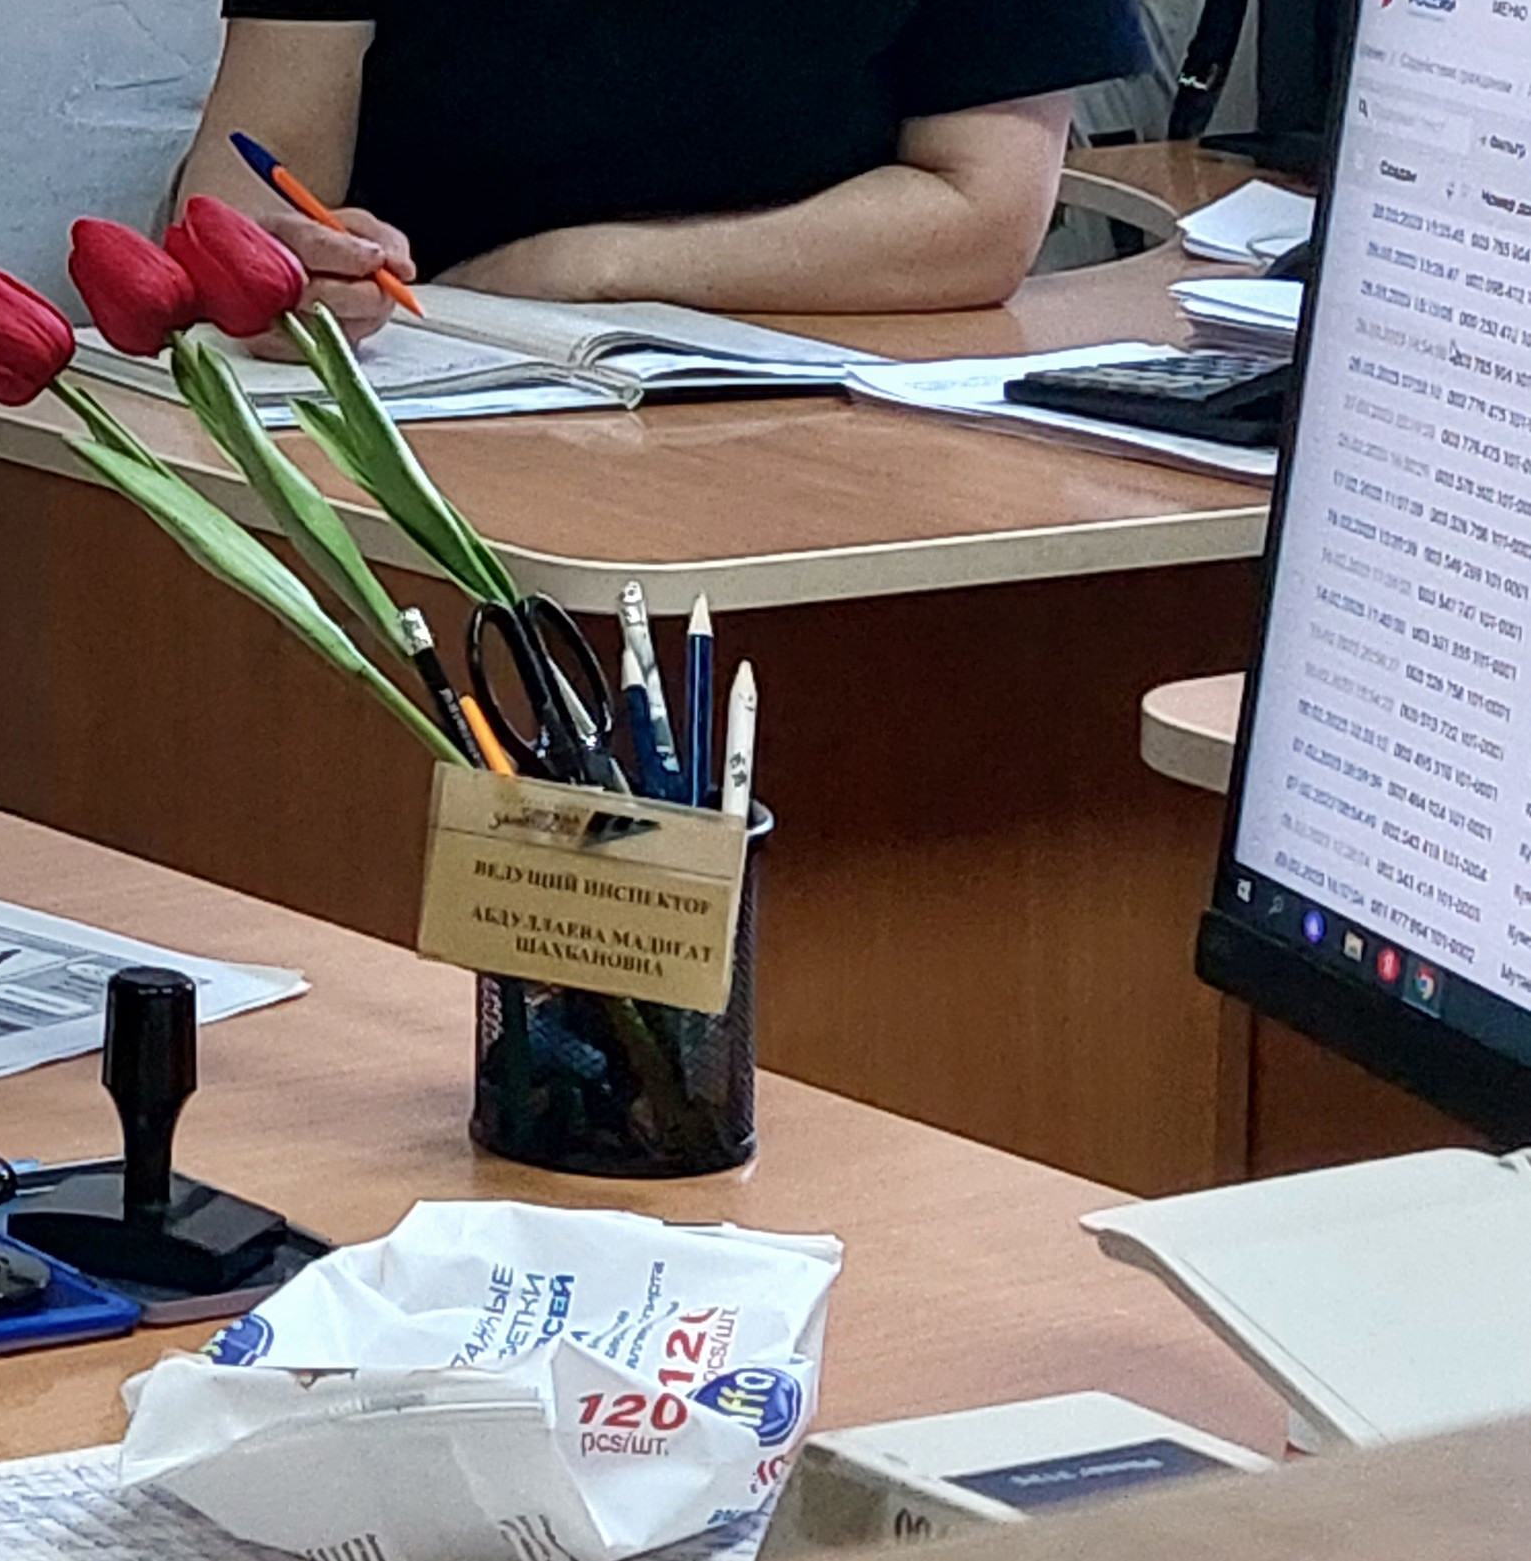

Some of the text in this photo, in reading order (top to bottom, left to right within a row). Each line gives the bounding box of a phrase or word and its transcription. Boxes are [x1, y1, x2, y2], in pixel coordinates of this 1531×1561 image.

[472, 858, 713, 917] ВЕДУЩИЙ ИНСПЕКТОР
[471, 903, 604, 944] АБДУЛЛАЕВА
[514, 933, 665, 978] ШАХБАНОВНА
[578, 1392, 688, 1430] 120
